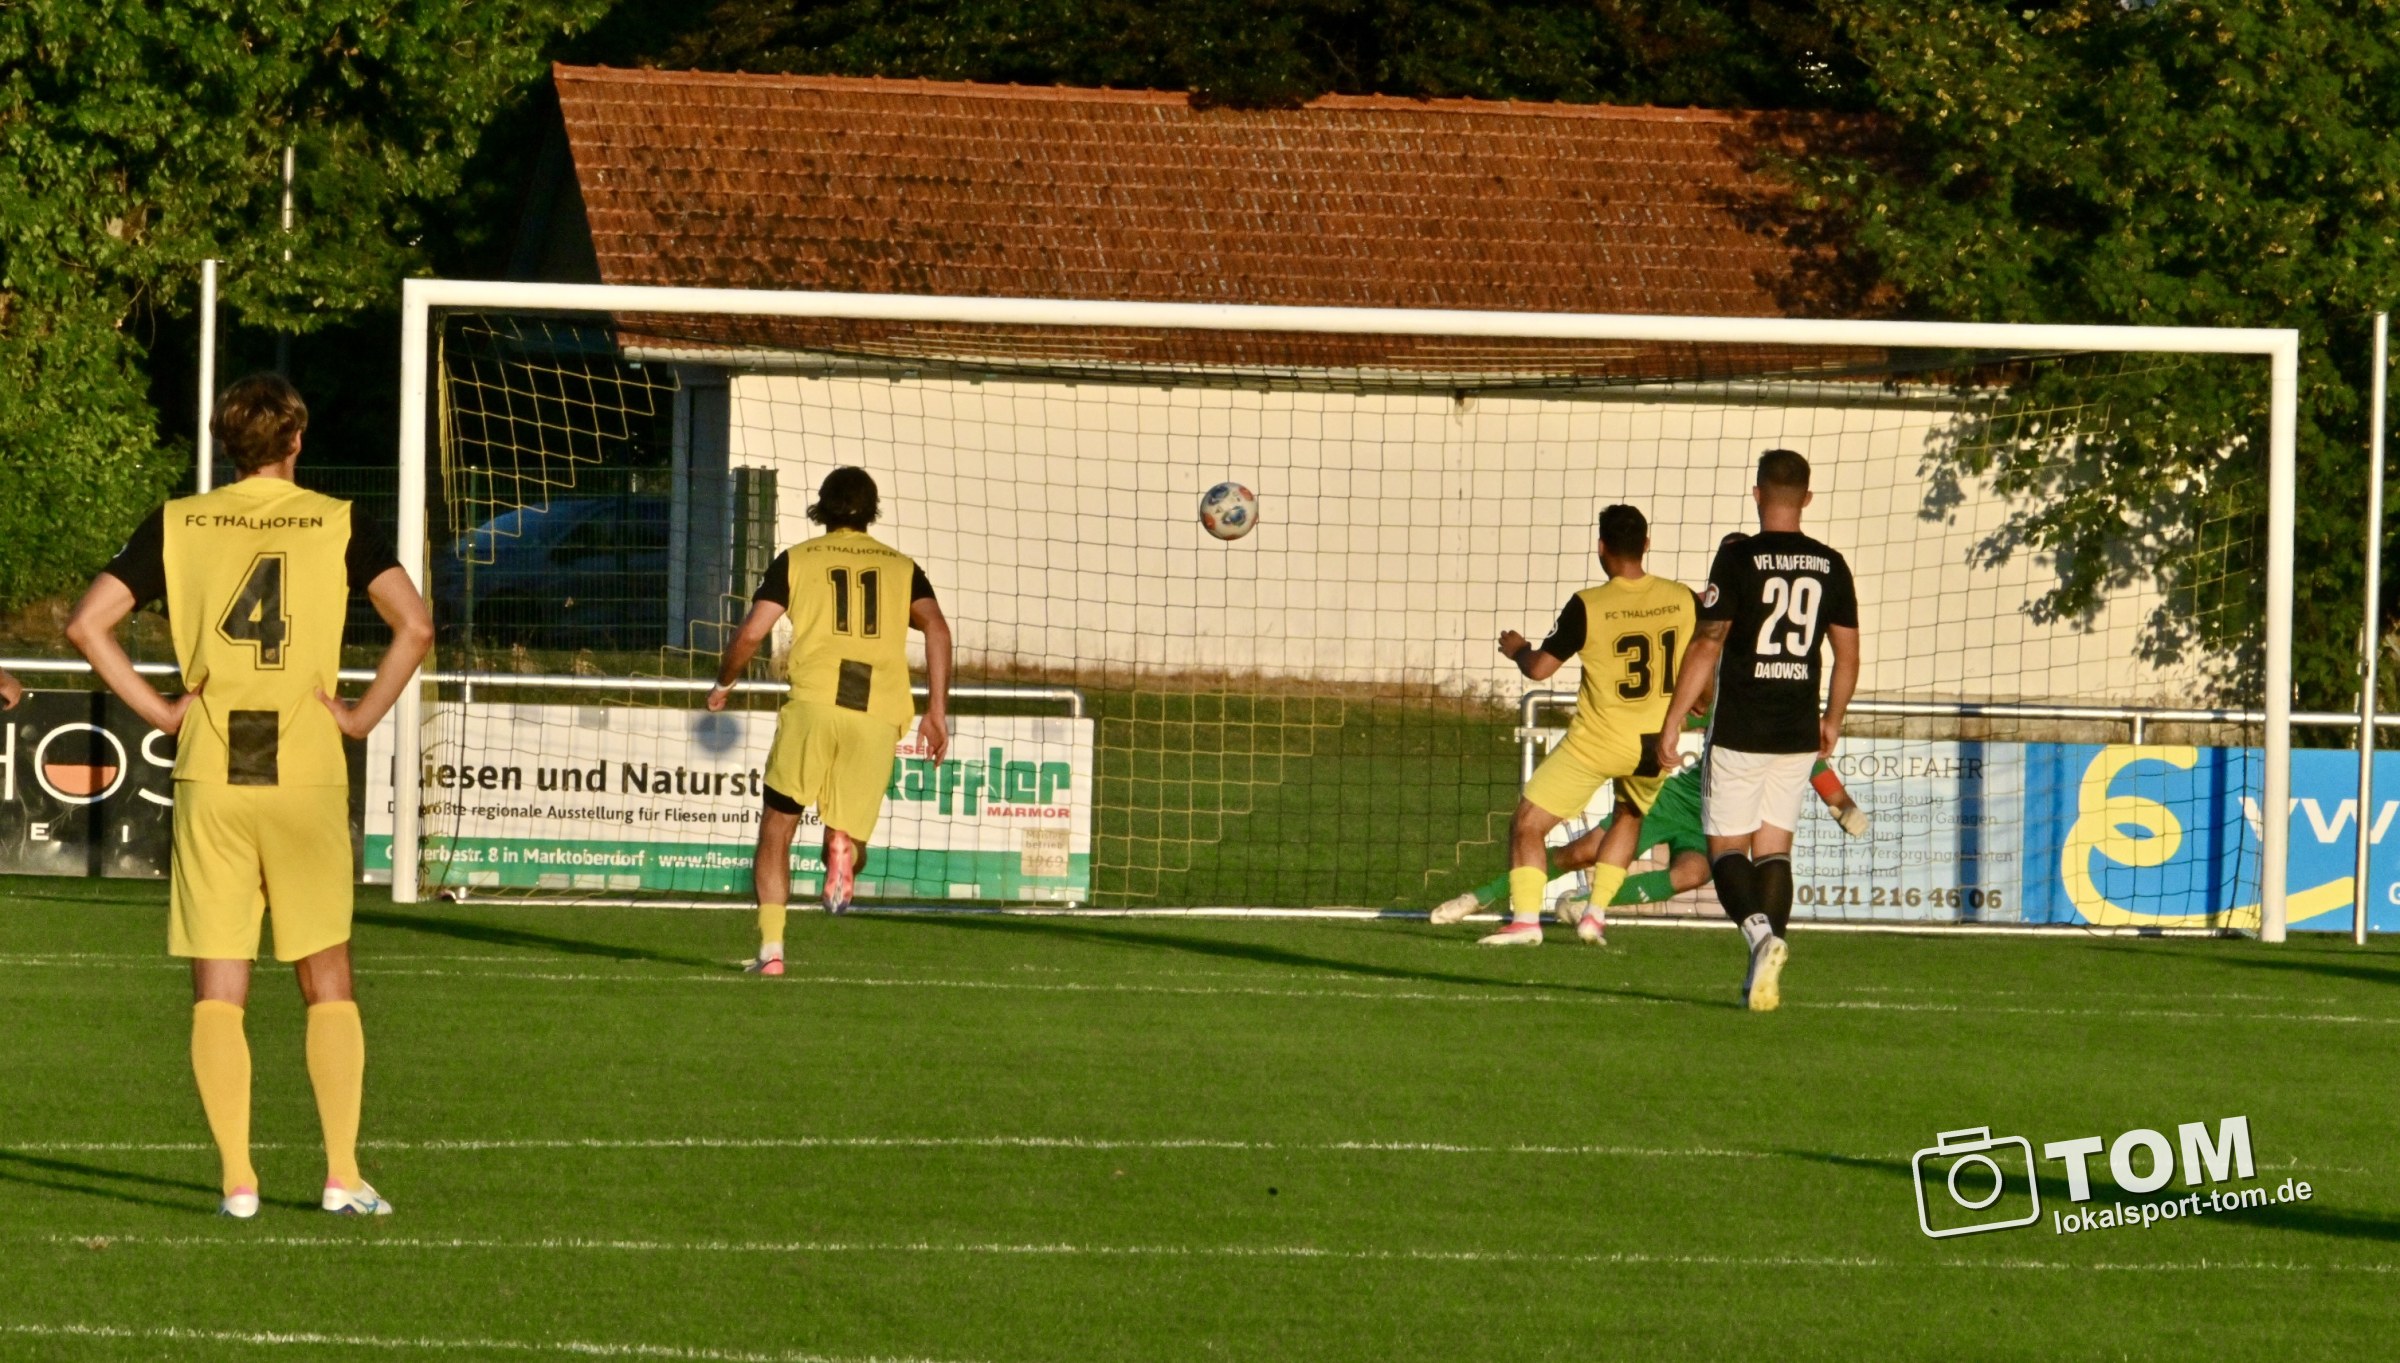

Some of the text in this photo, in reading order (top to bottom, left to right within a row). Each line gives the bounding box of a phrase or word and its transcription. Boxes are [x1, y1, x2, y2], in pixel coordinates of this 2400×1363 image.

[185, 515, 323, 529] FC THALHOFEN
[826, 545, 897, 558] THALHOFEN
[1753, 554, 1776, 571] VFL
[215, 551, 292, 670] 4
[826, 565, 881, 639] 11
[1605, 604, 1681, 620] FC THALHOFEN
[1756, 576, 1822, 657] 29
[1612, 626, 1679, 703] 31
[390, 753, 761, 798] iesen und Naturst
[1837, 755, 1984, 779] GOR FAHR
[471, 803, 543, 820] regionale
[547, 805, 634, 824] Ausstellung
[639, 807, 660, 822] für
[665, 809, 716, 823] Fliesen
[722, 811, 749, 824] und
[986, 806, 1071, 818] MARMOR
[488, 847, 499, 862] 8
[503, 846, 519, 862] in
[523, 848, 646, 867] Marktoberdorf
[1797, 884, 2003, 909] 0171 216 46 06
